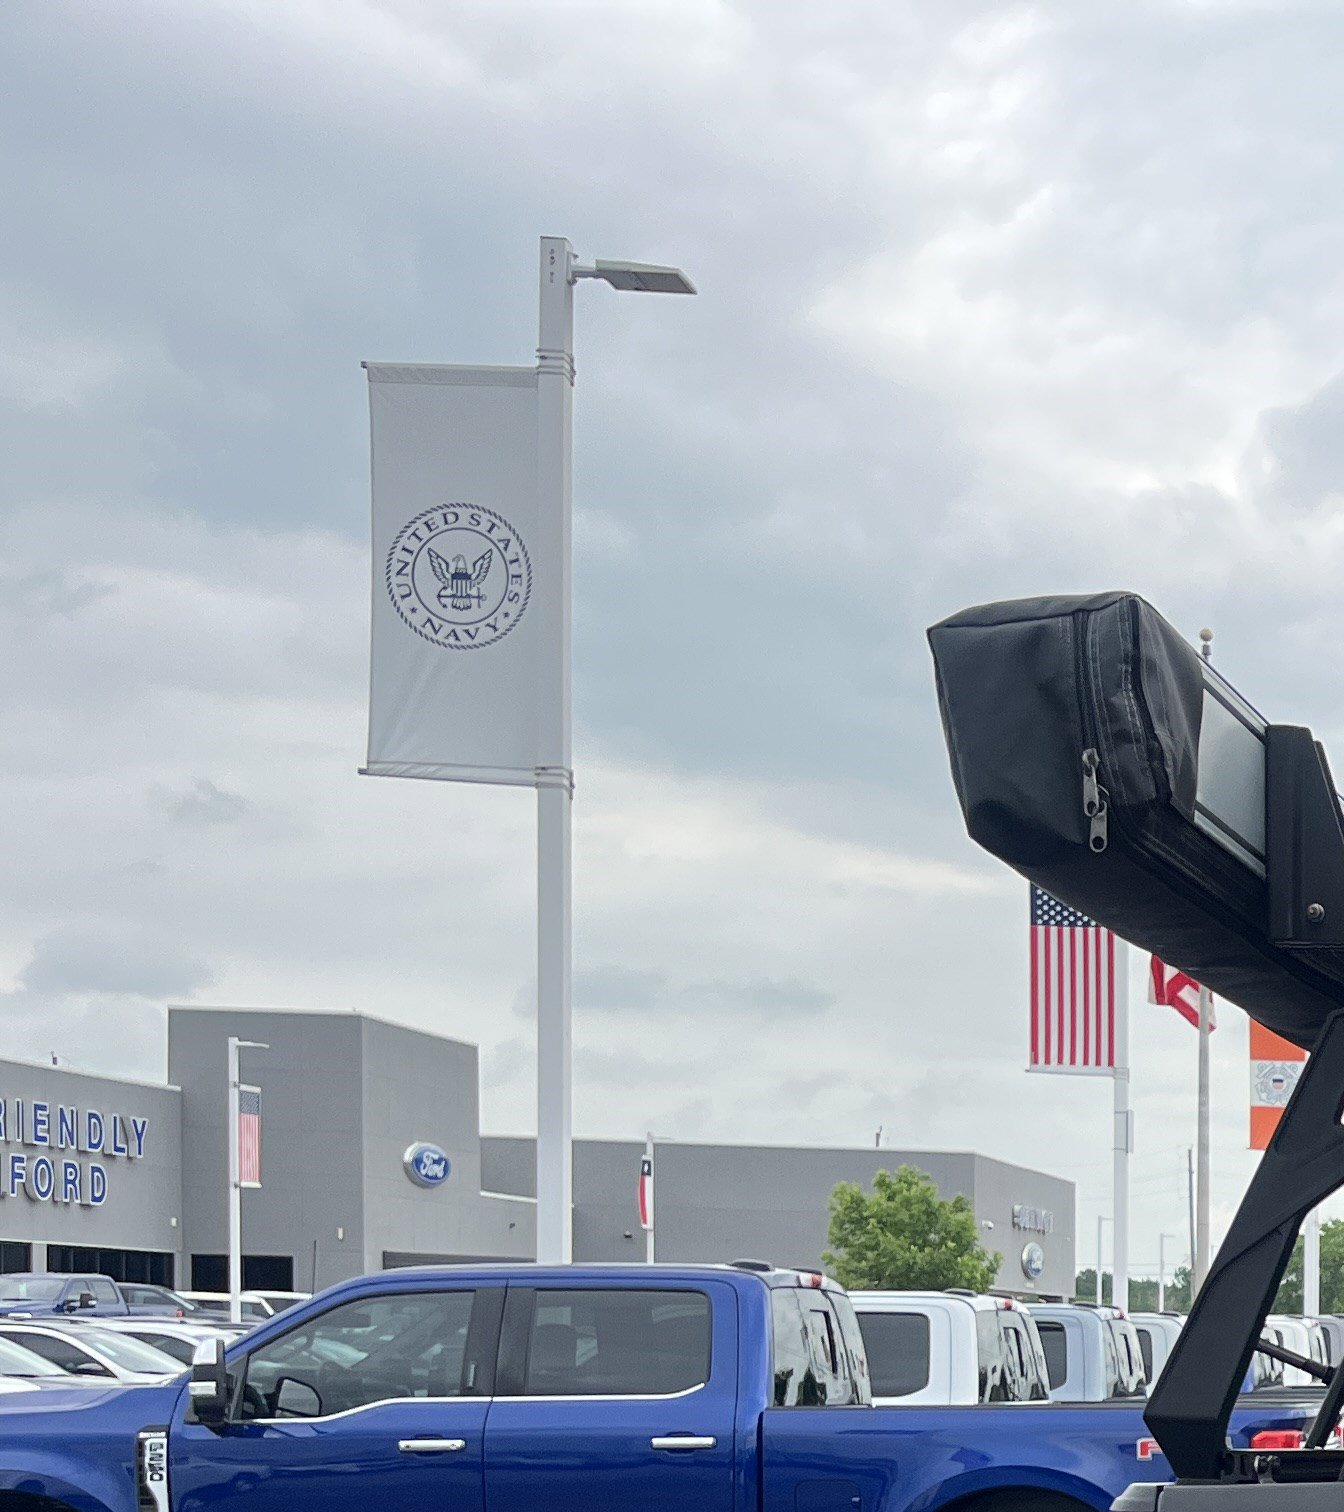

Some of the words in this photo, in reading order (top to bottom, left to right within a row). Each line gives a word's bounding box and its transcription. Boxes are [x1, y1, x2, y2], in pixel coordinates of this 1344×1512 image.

[396, 511, 460, 602] UNITED
[468, 512, 523, 604] STATES
[420, 616, 500, 642] NAVY
[9, 1153, 108, 1206] FORD
